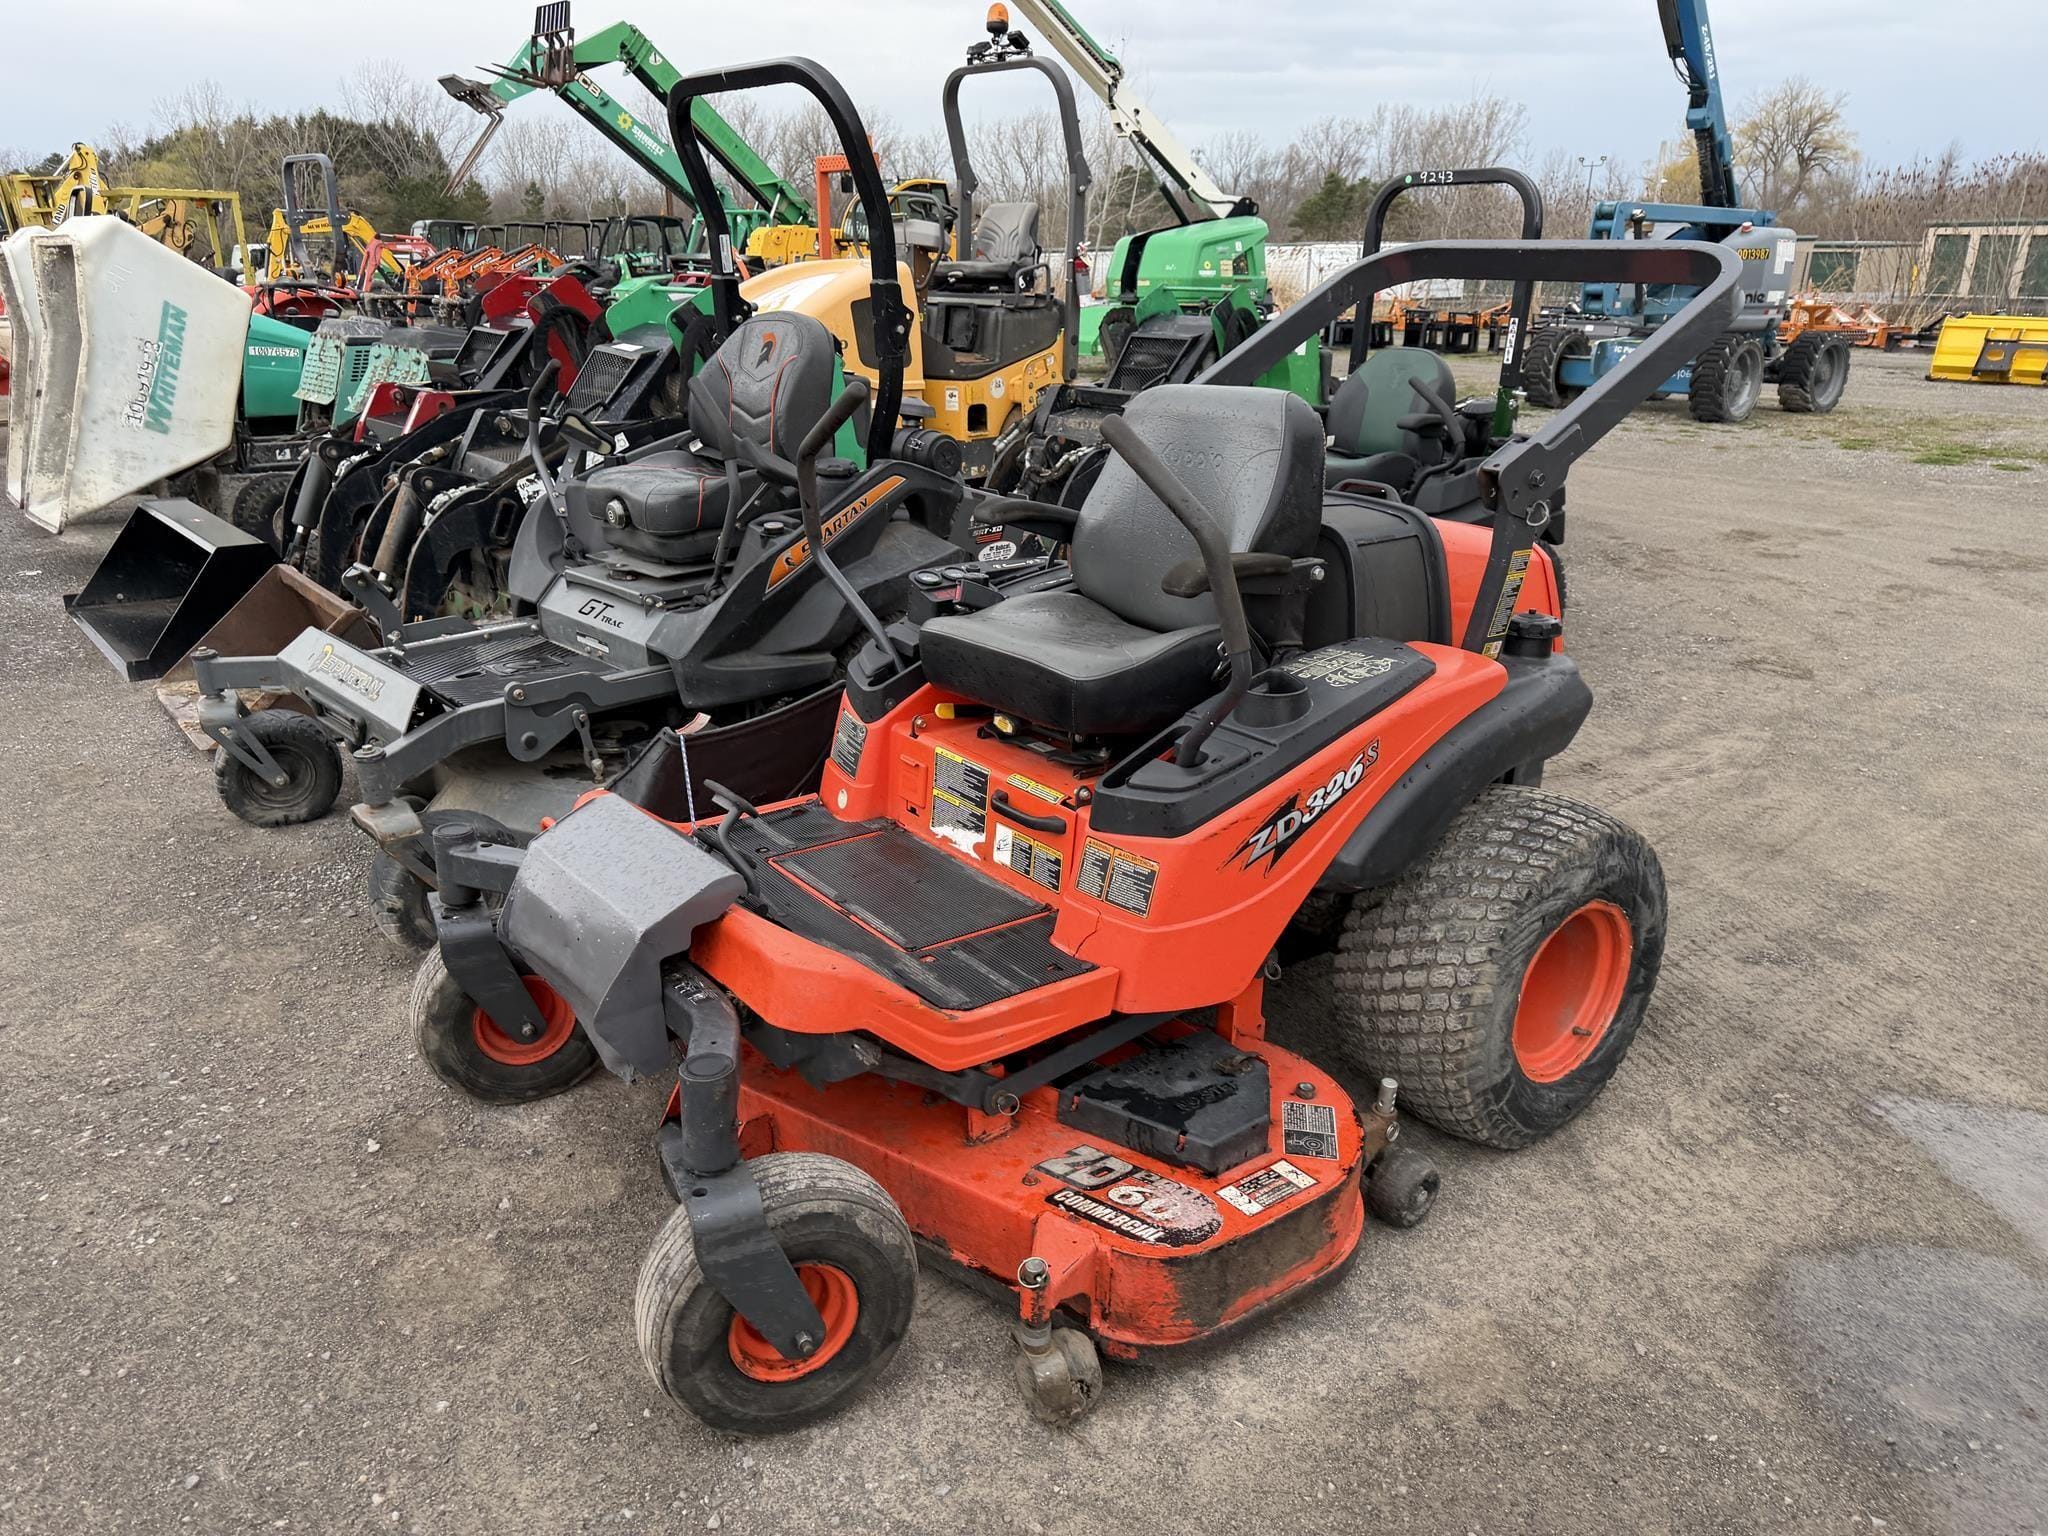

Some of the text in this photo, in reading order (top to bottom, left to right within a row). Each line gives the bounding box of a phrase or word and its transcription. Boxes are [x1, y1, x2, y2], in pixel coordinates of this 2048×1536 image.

[1420, 171, 1453, 184] 9243
[1745, 289, 1765, 304] nie
[145, 299, 188, 435] WHITEMAN
[801, 498, 868, 553] SARTAN
[578, 598, 614, 619] GT
[601, 615, 624, 628] TRAC
[1053, 1190, 1166, 1242] COMMERCIAL
